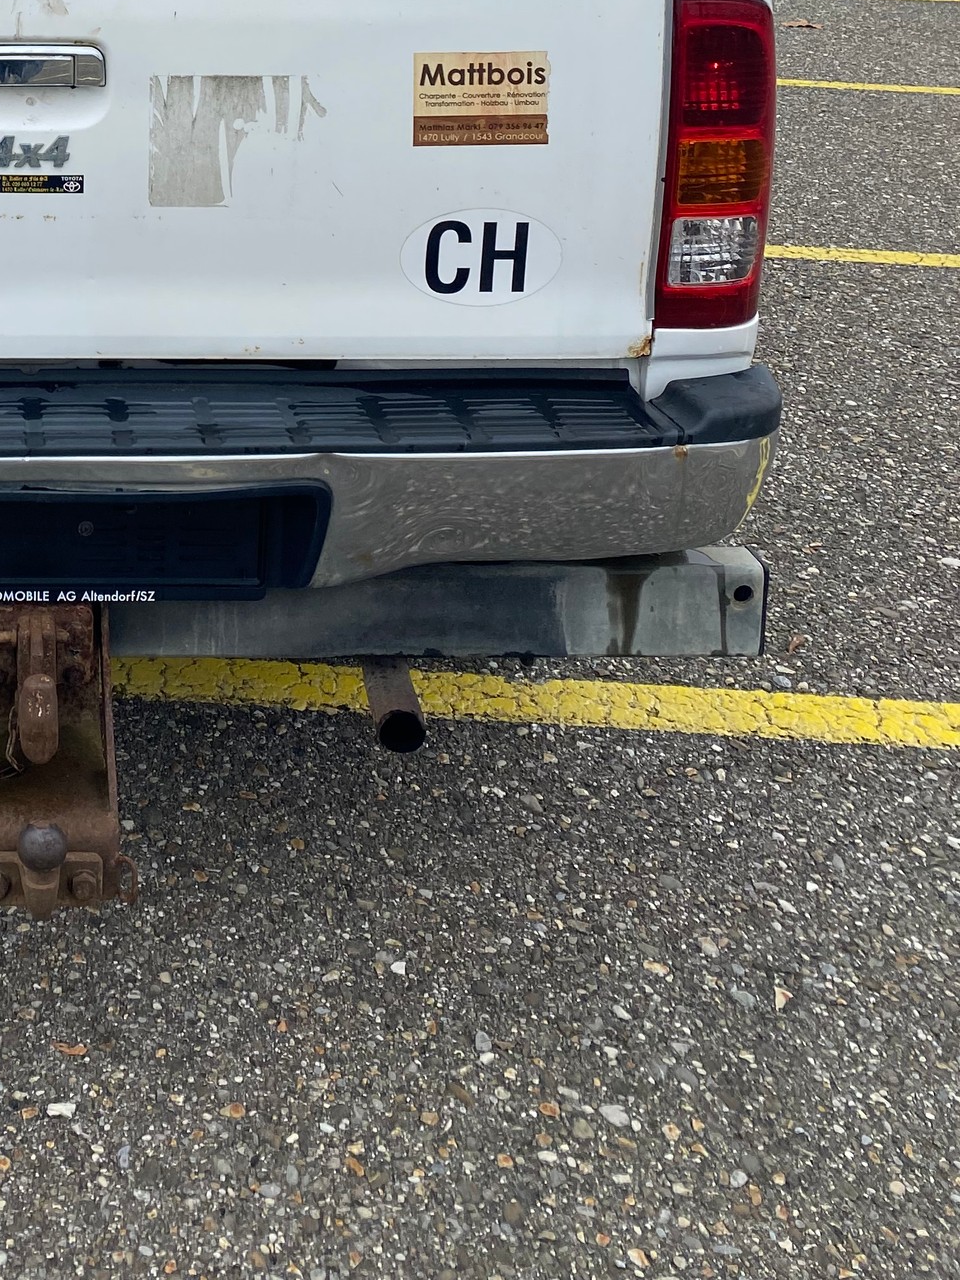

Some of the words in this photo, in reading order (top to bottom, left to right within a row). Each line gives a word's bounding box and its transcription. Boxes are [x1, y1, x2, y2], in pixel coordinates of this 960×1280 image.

[419, 61, 546, 86] Mattbois
[419, 92, 456, 100] Charpente
[462, 91, 501, 99] Couverture
[488, 122, 503, 130] 079
[418, 133, 438, 141] 1470
[440, 133, 460, 142] Lully
[472, 132, 492, 141] 1543
[494, 131, 544, 141] Grandcour
[424, 219, 530, 295] CH
[57, 590, 76, 602] AG
[81, 590, 156, 602] Altendorf/SZ
